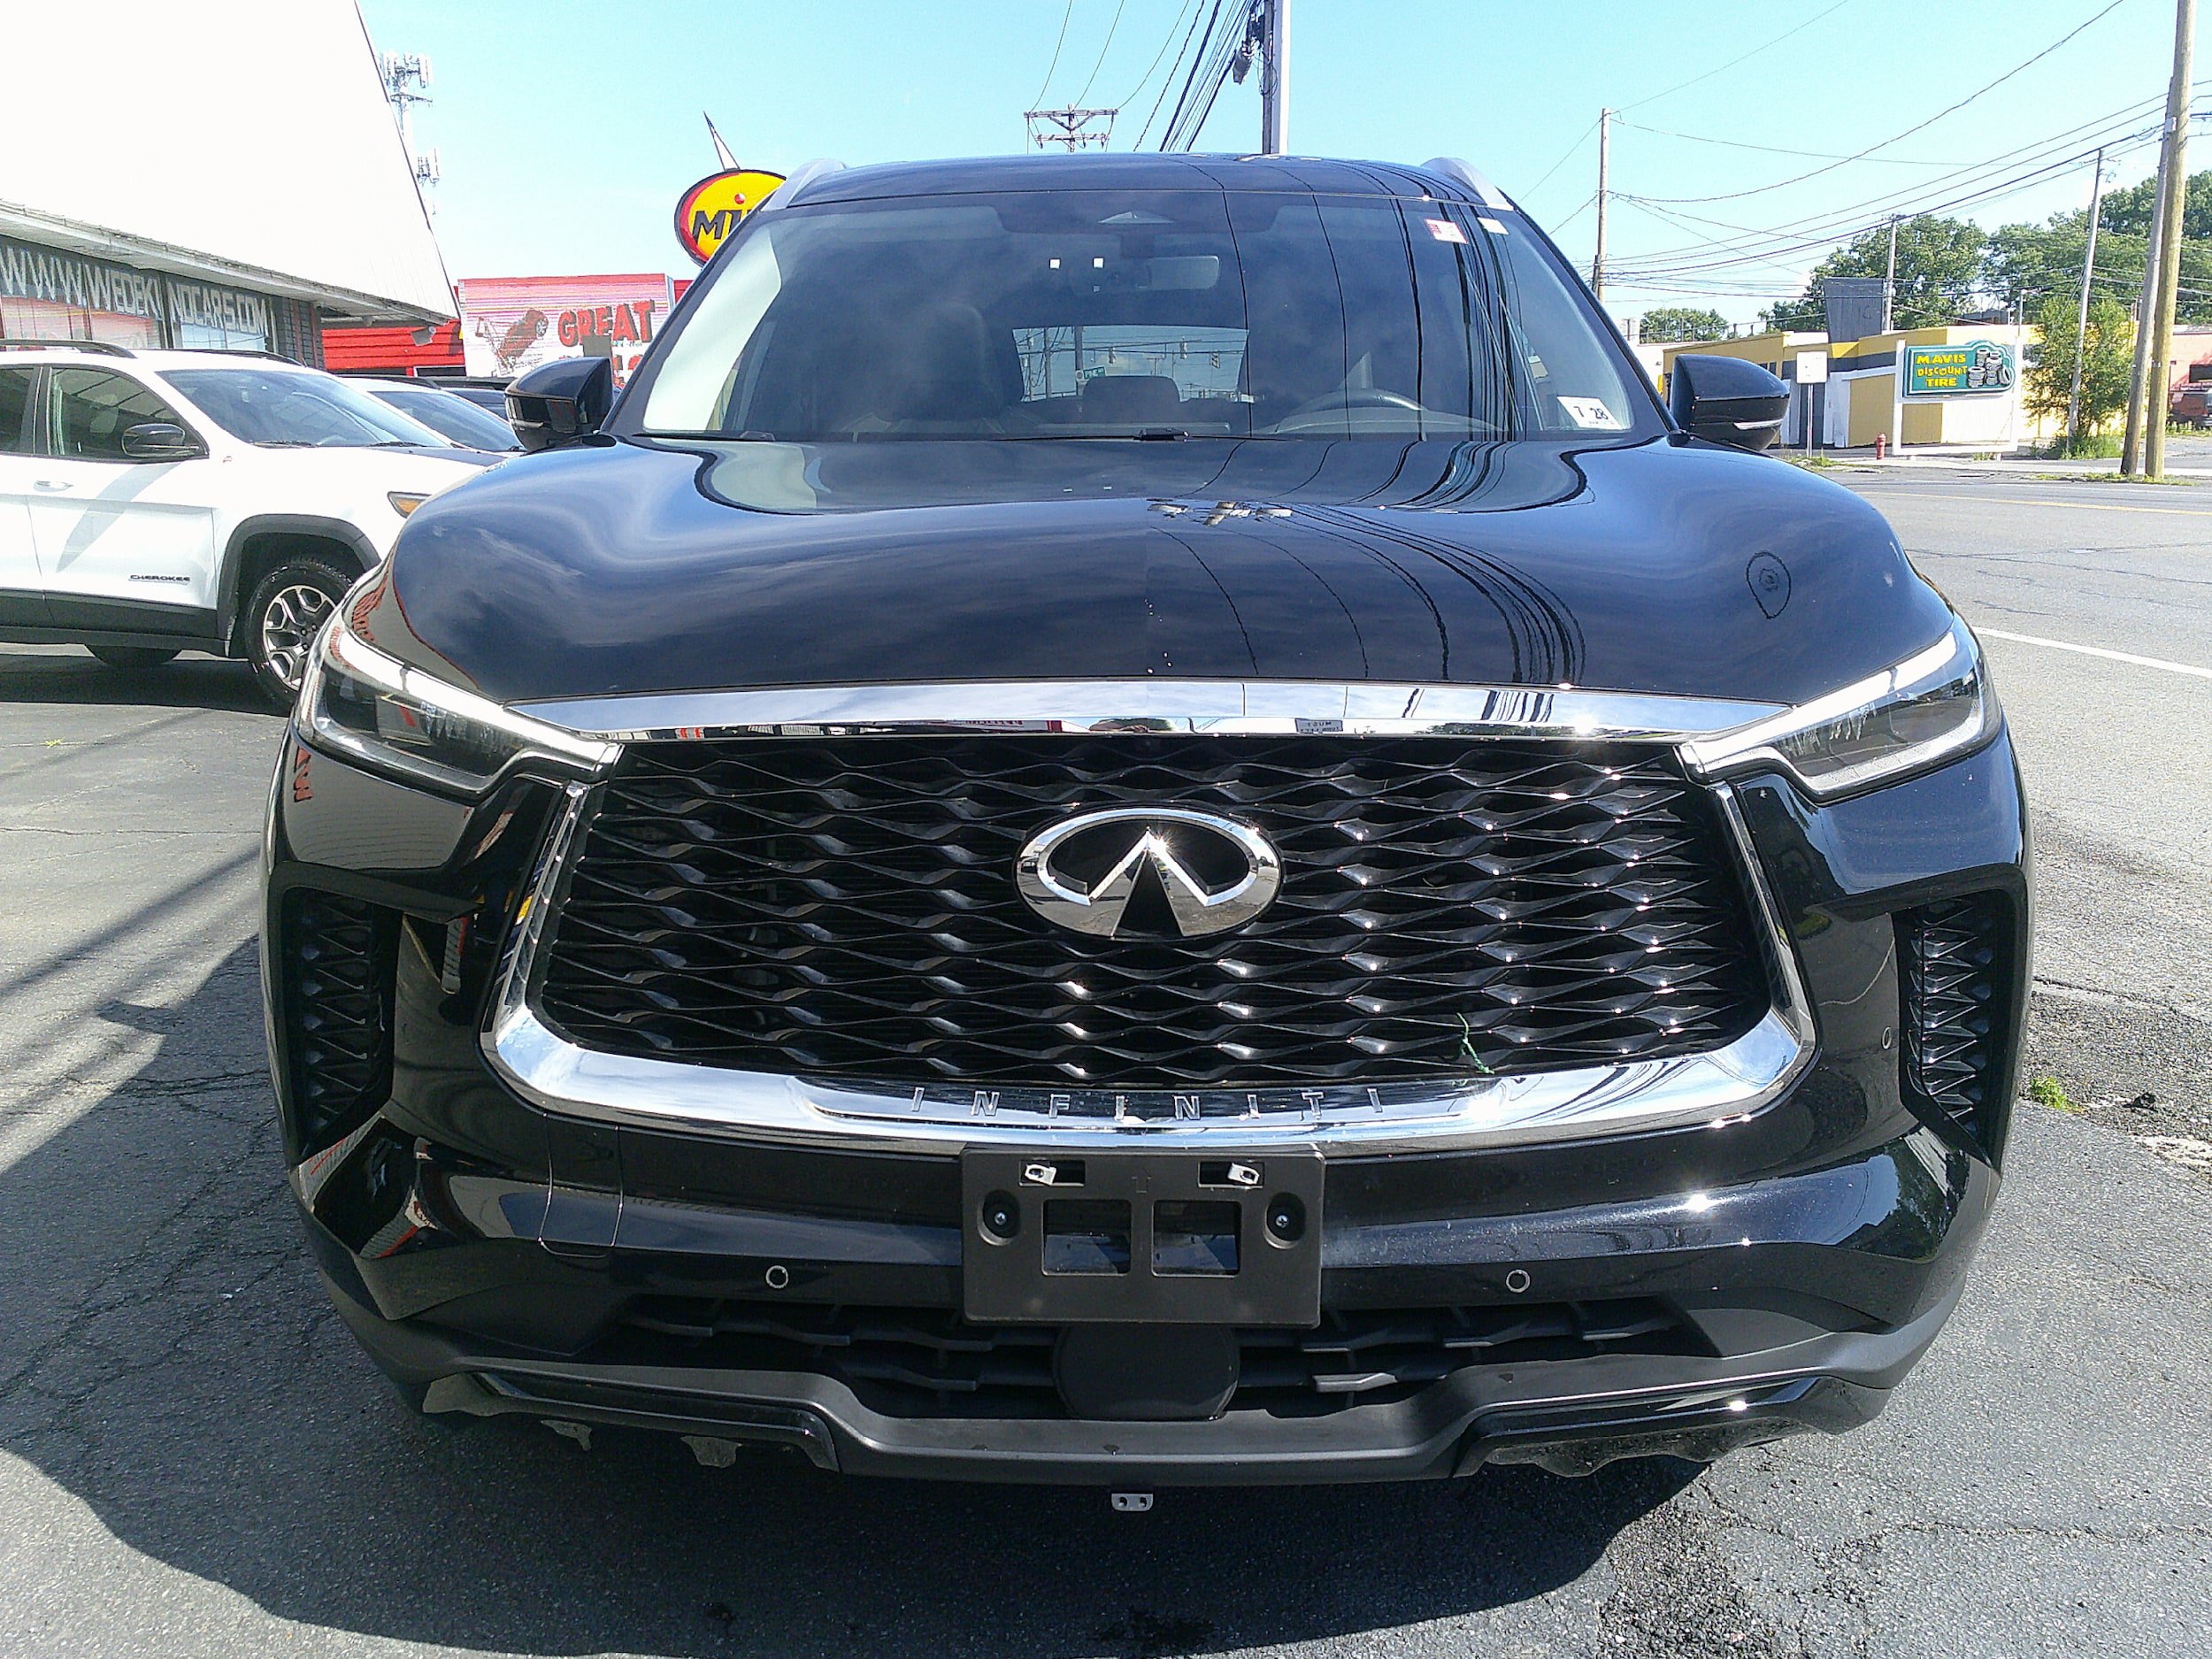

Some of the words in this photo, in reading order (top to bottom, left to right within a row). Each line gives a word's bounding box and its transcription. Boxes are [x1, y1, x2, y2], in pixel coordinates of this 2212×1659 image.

[558, 299, 656, 347] GREAT
[1916, 354, 1966, 365] MAVIS
[1917, 365, 1968, 377] DISCOUNT
[1925, 377, 1957, 388] TIRE
[910, 1087, 1384, 1121] INFINITI
